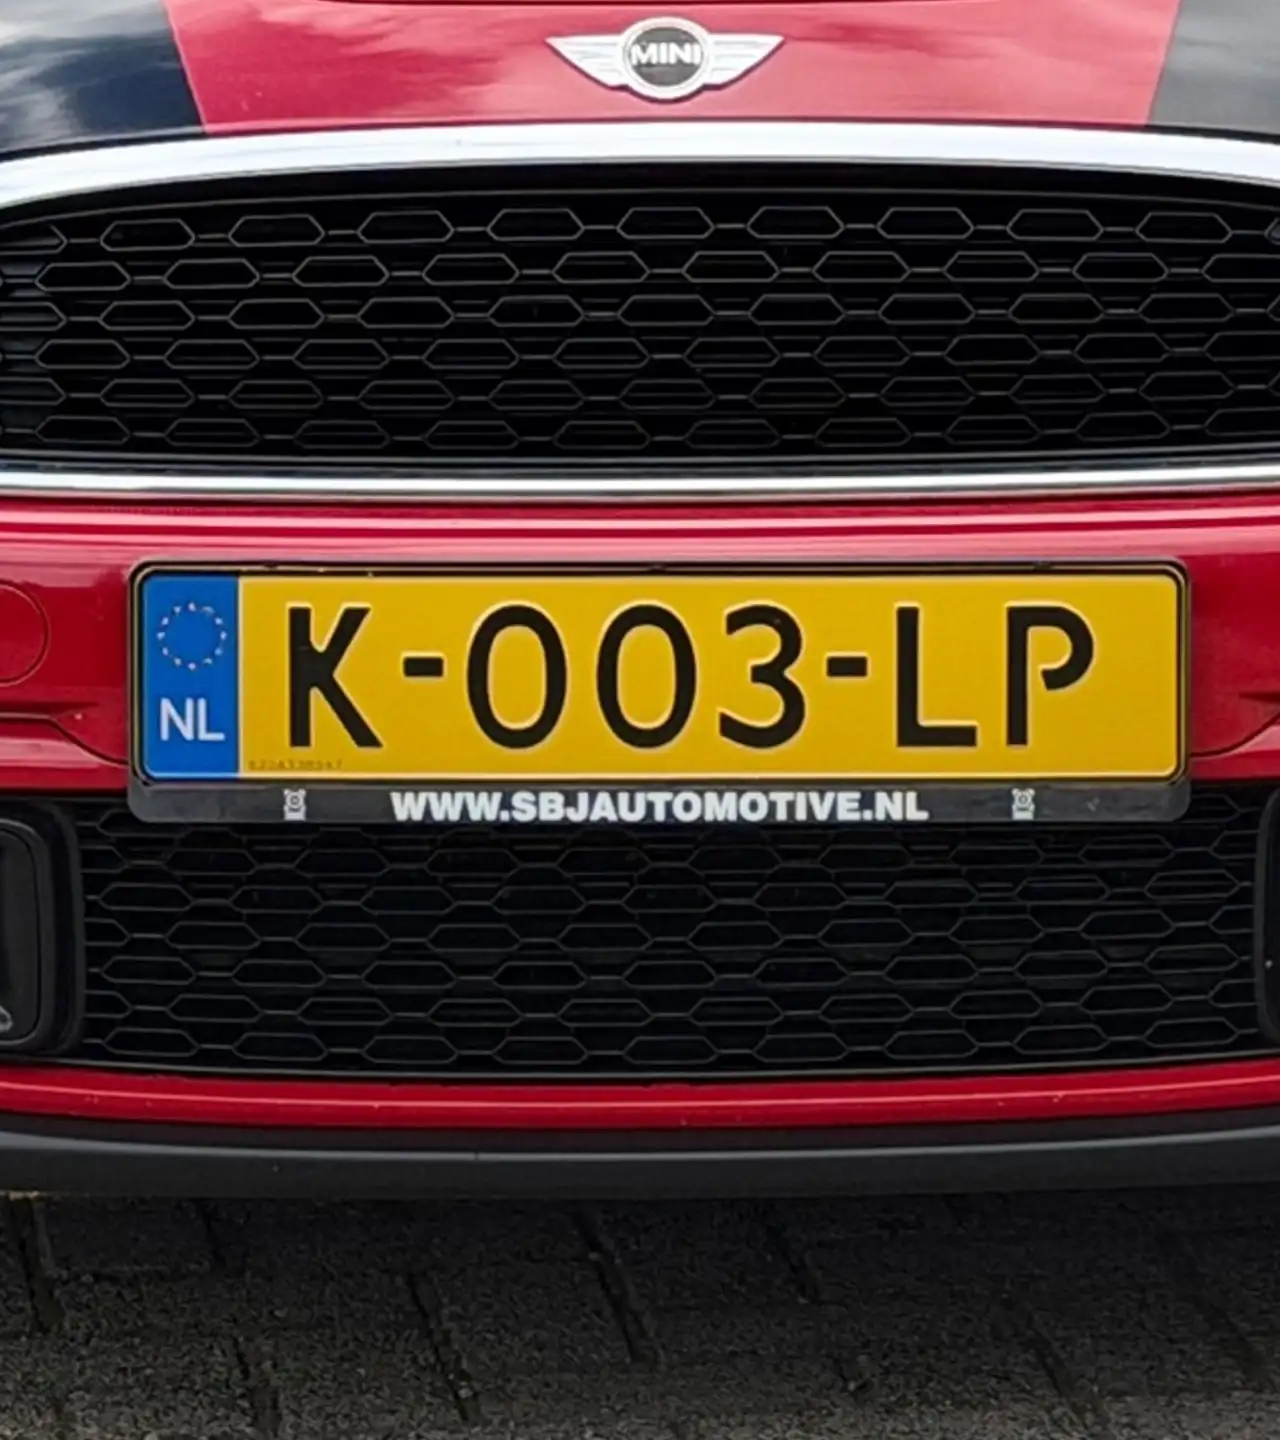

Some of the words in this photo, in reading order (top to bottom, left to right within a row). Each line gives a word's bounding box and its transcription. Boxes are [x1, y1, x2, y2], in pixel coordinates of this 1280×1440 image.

[630, 41, 703, 66] MINI
[288, 603, 1094, 748] K-003-LP
[160, 698, 225, 741] NL
[391, 790, 929, 822] WWW.SBJAUTOMOTIVE.NL
